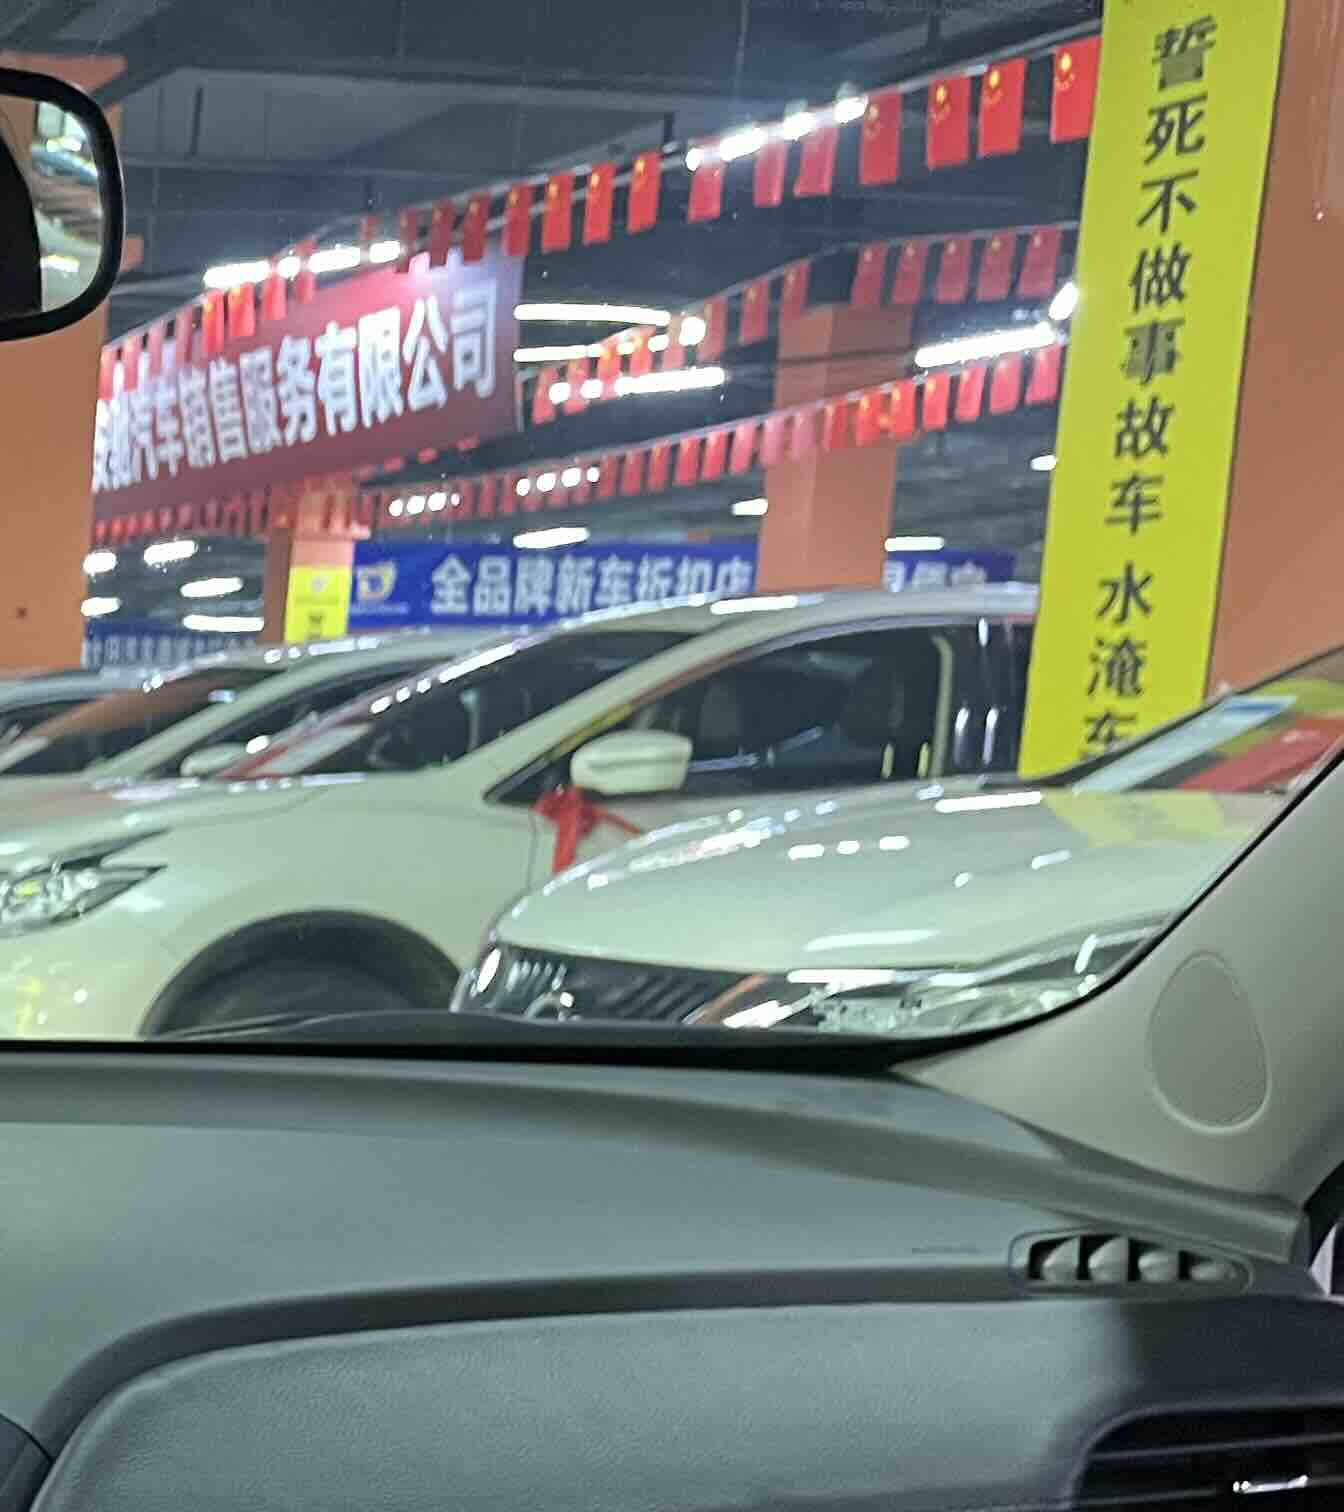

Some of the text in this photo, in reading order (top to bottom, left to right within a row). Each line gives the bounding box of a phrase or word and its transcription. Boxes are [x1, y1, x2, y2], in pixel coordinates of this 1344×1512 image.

[1103, 15, 1218, 539] 誓死不做事故车
